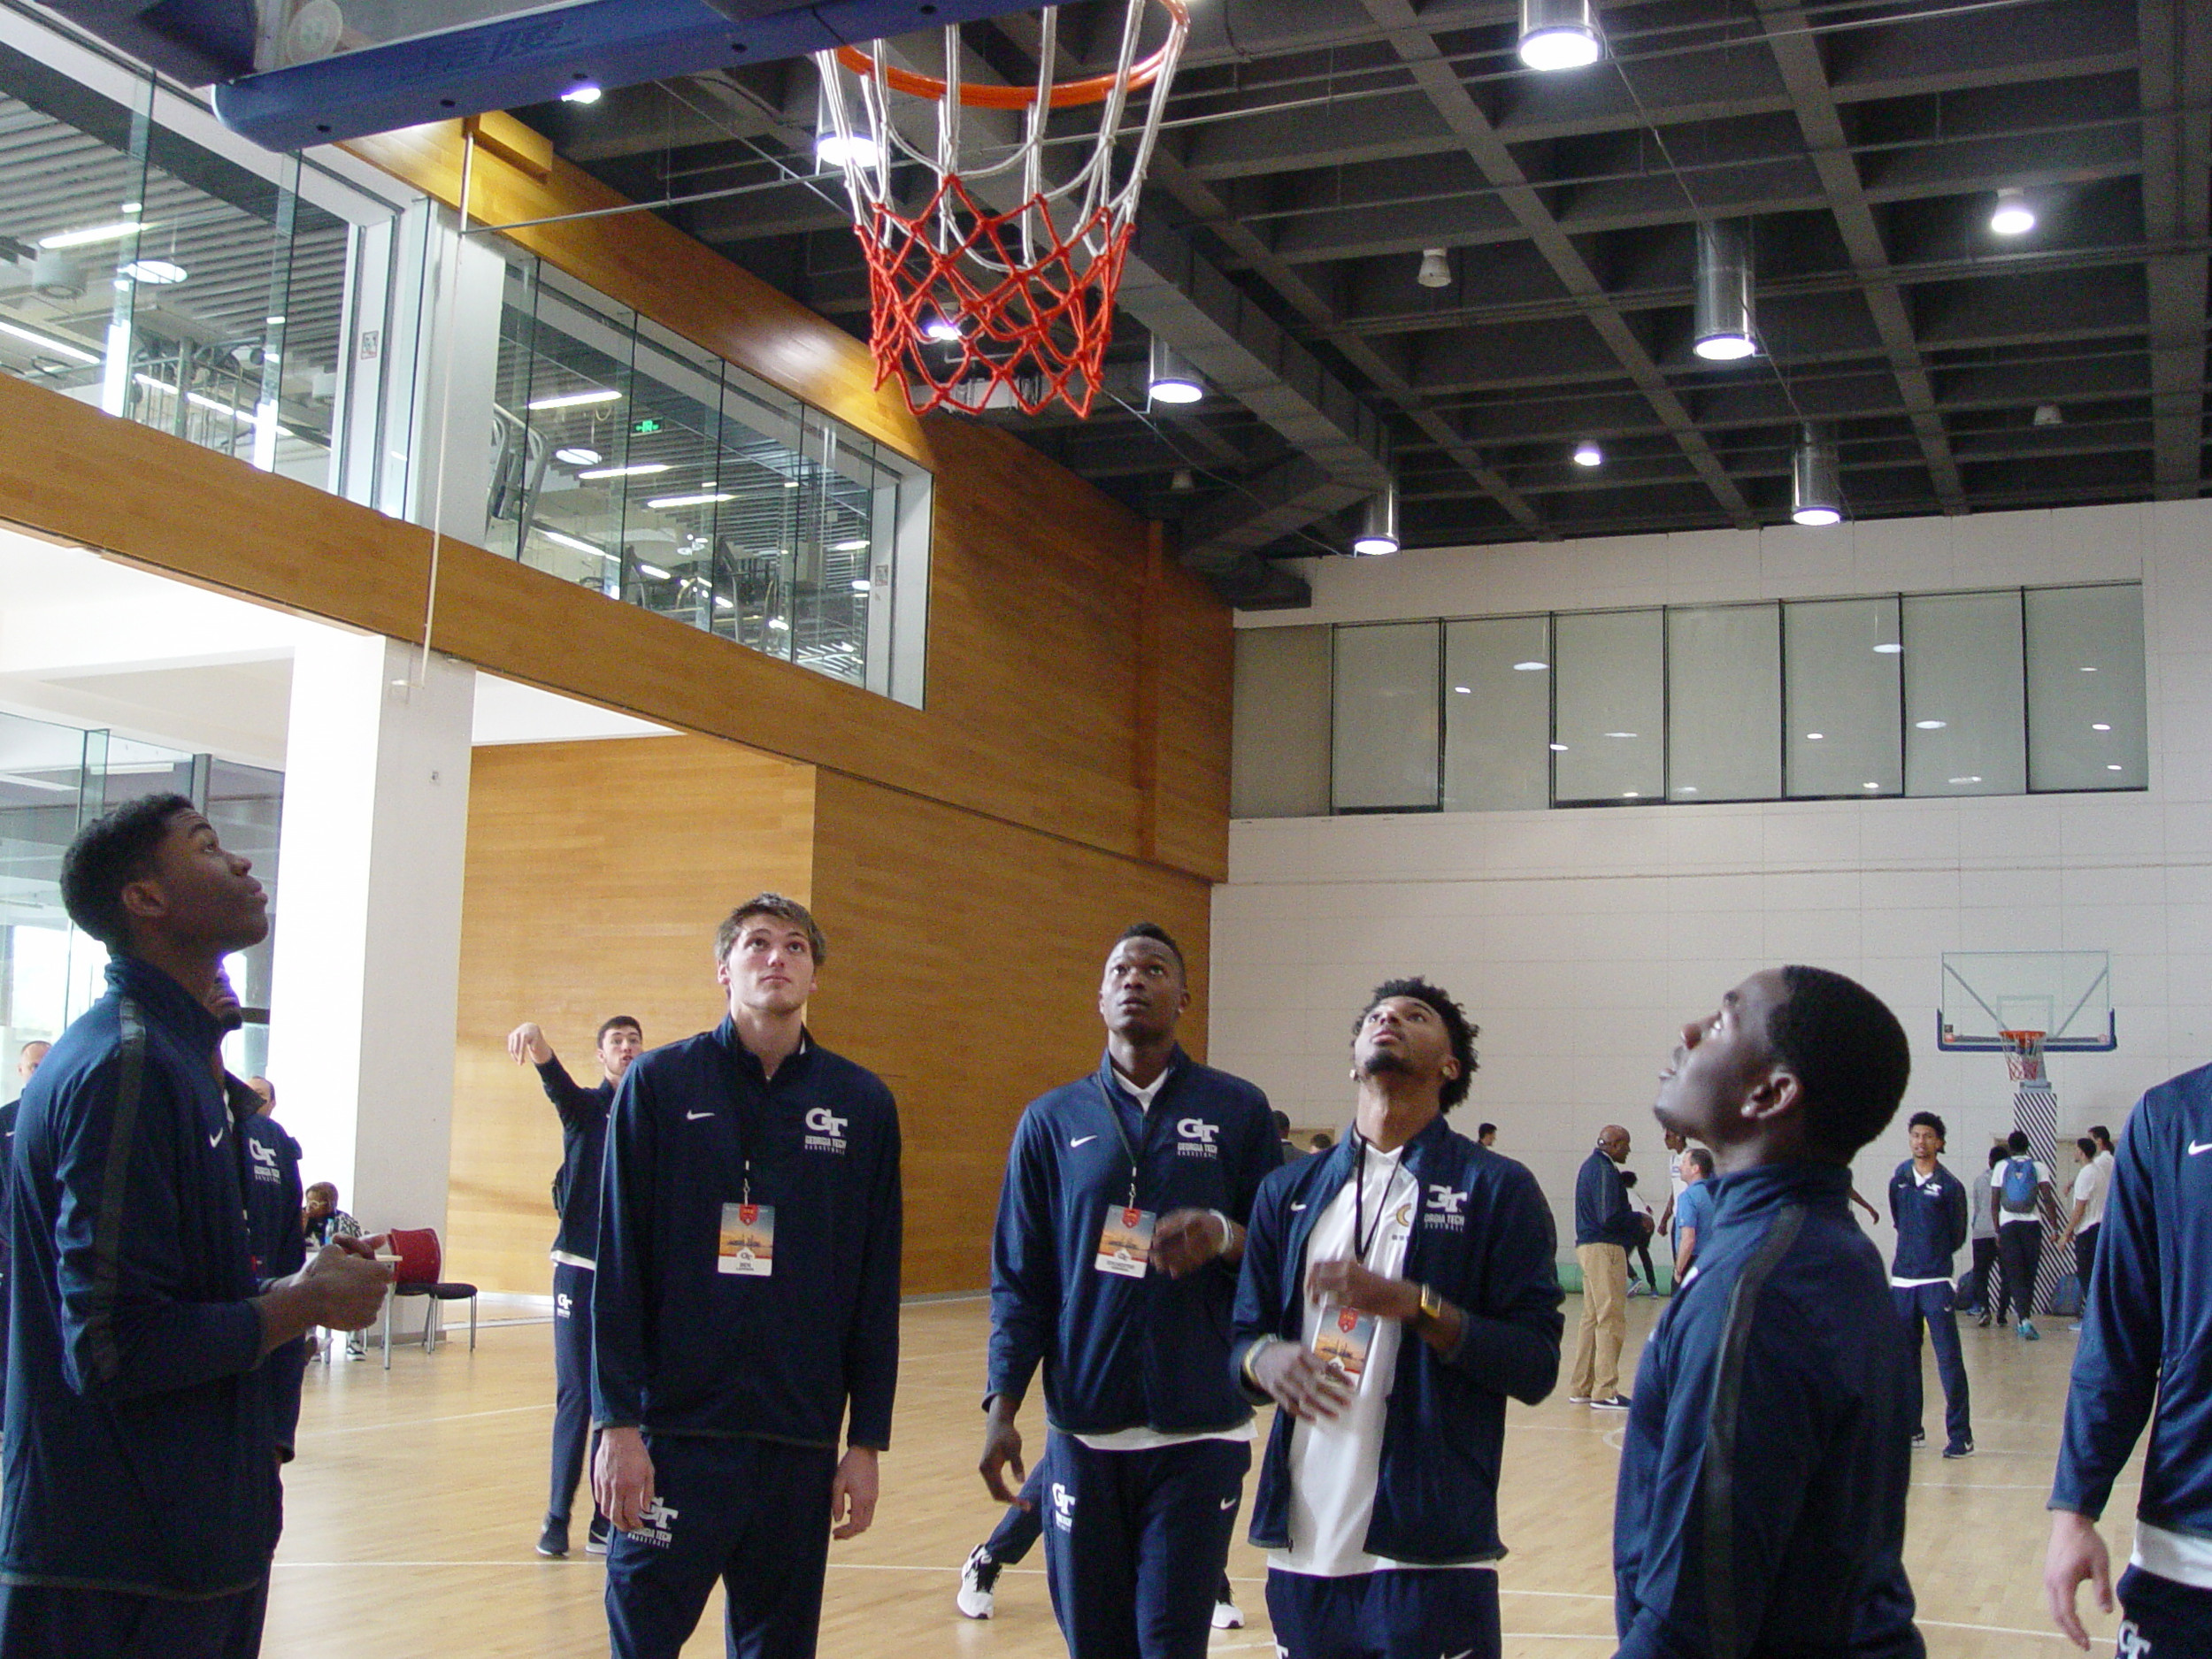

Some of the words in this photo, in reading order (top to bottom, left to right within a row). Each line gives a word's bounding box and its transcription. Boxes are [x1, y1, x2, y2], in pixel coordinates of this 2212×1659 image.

[805, 1107, 849, 1136] GT
[1177, 1118, 1219, 1142] GT
[250, 1137, 277, 1167] GT
[1447, 1213, 1465, 1226] TECH
[1052, 1482, 1076, 1516] GT
